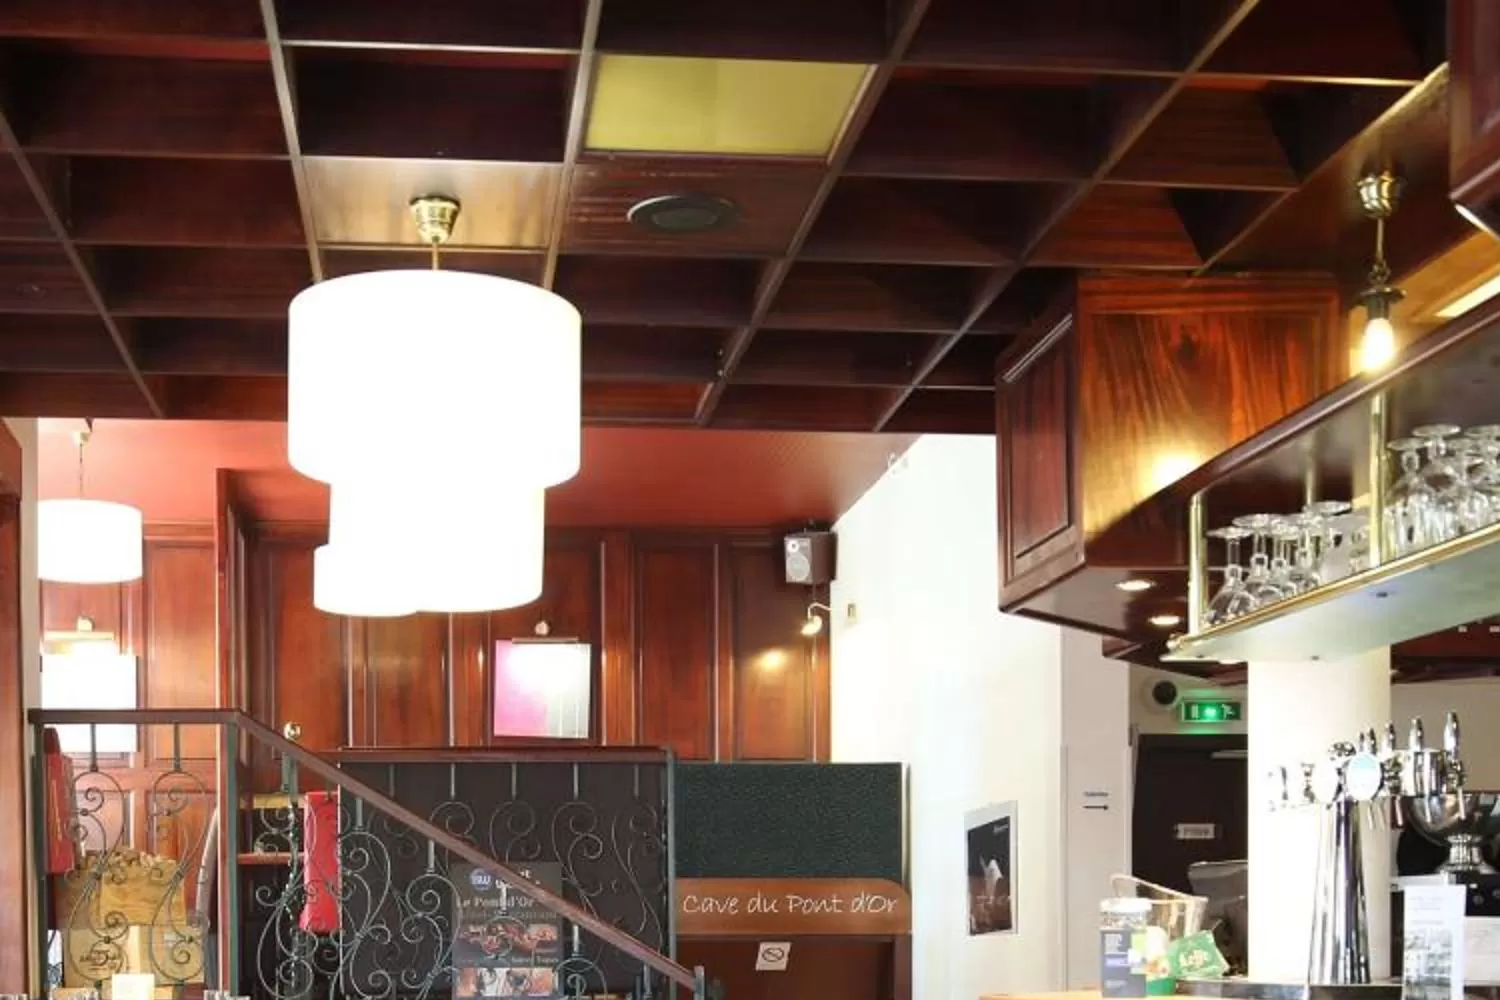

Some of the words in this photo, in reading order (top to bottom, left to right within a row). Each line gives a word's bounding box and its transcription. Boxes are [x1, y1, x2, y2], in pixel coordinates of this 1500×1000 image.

[682, 894, 739, 915] Cave
[746, 889, 780, 914] du
[786, 893, 843, 915] Pont
[850, 890, 899, 914] d'Or
